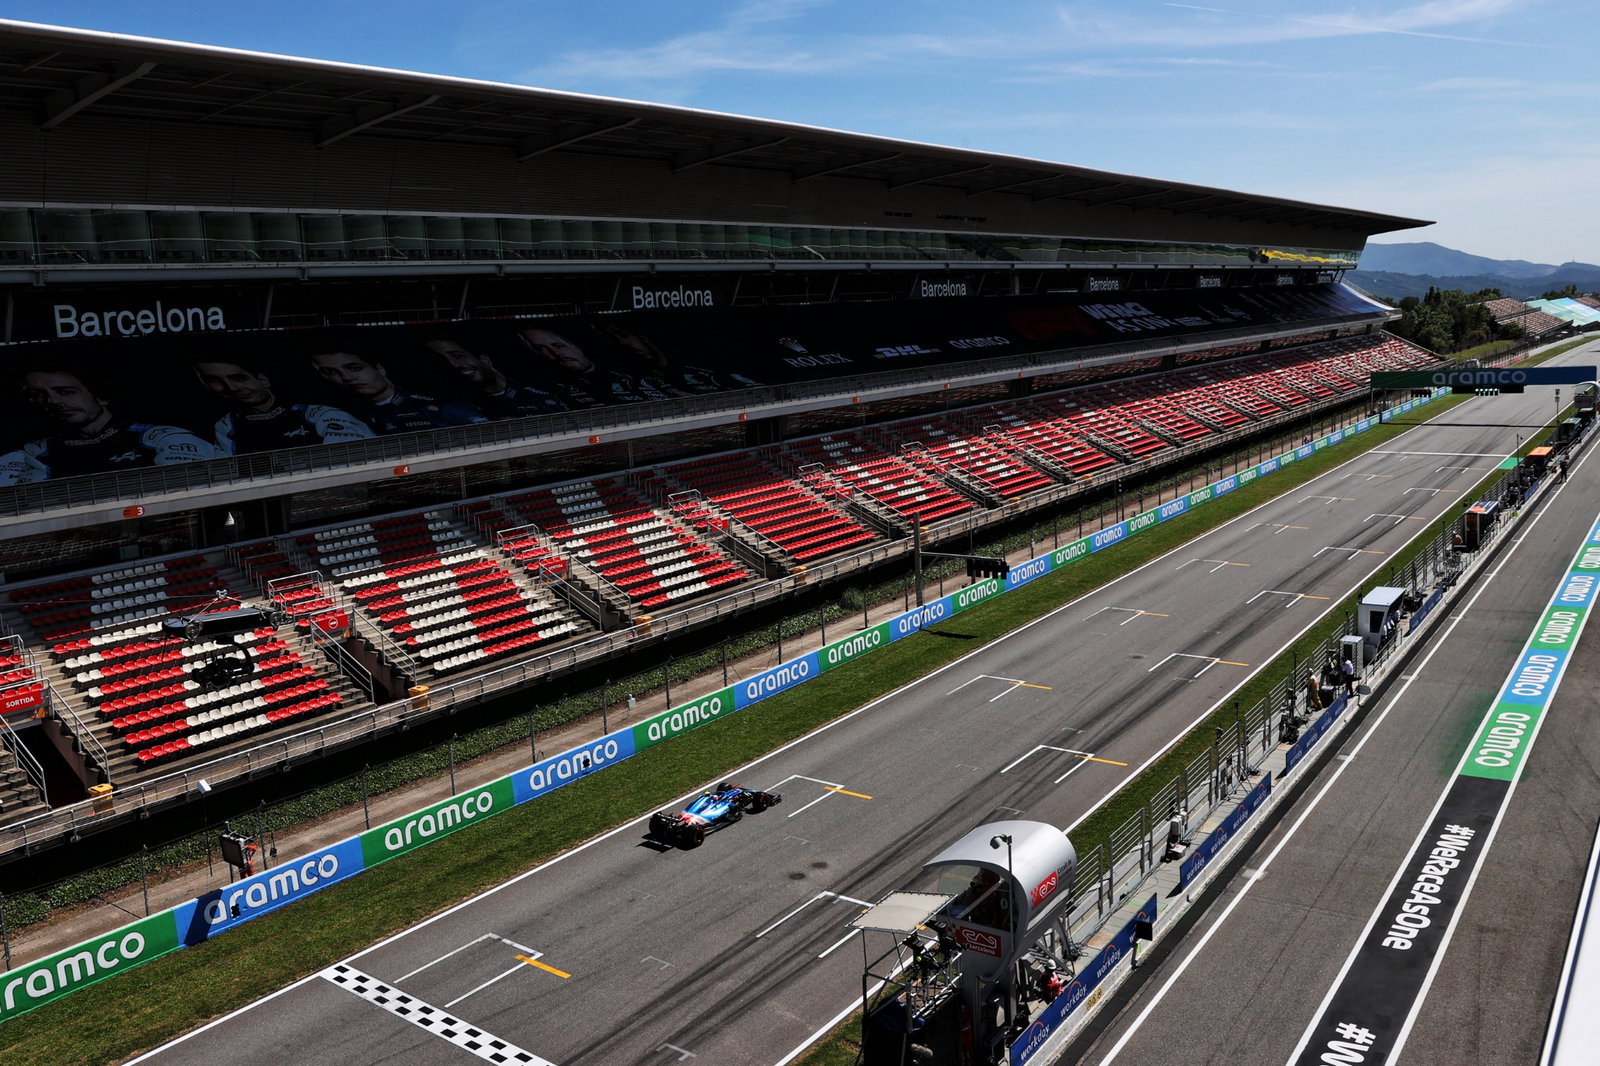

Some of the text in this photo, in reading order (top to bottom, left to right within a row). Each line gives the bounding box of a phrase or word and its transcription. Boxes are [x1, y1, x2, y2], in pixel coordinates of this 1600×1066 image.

[632, 285, 714, 309] Barcelona
[921, 280, 967, 298] Barcelona
[1090, 277, 1120, 291] Barcelona
[54, 301, 226, 338] Barcelona
[875, 344, 932, 358] DHL
[949, 335, 1011, 349] aramco
[783, 353, 853, 368] ROLEX
[1432, 370, 1527, 385] aramco
[403, 466, 409, 474] 4
[1161, 500, 1184, 517] aramco
[1191, 489, 1211, 505] aramco
[136, 507, 144, 516] 3
[1131, 512, 1154, 531] aramco
[1095, 526, 1123, 547] aramco
[1056, 542, 1086, 564] aramco
[1011, 560, 1045, 584] aramco
[959, 579, 998, 607] aramco
[1560, 575, 1595, 602] aramco
[899, 603, 944, 633] aramco
[1538, 611, 1578, 644] aramco
[828, 630, 881, 664] aramco
[747, 661, 809, 699] aramco
[1511, 655, 1558, 696] aramco
[6, 696, 35, 708] SORTIDA
[648, 697, 721, 741] aramco
[1474, 712, 1531, 767] aramco
[529, 739, 619, 791] aramco
[384, 791, 493, 851] aramco
[203, 854, 339, 925] aramco
[1381, 824, 1475, 951] #WeRaceAsOne
[0, 932, 146, 1013] ramco
[1096, 948, 1121, 979] workday
[1060, 985, 1087, 1018] workday
[1020, 1024, 1050, 1061] workday
